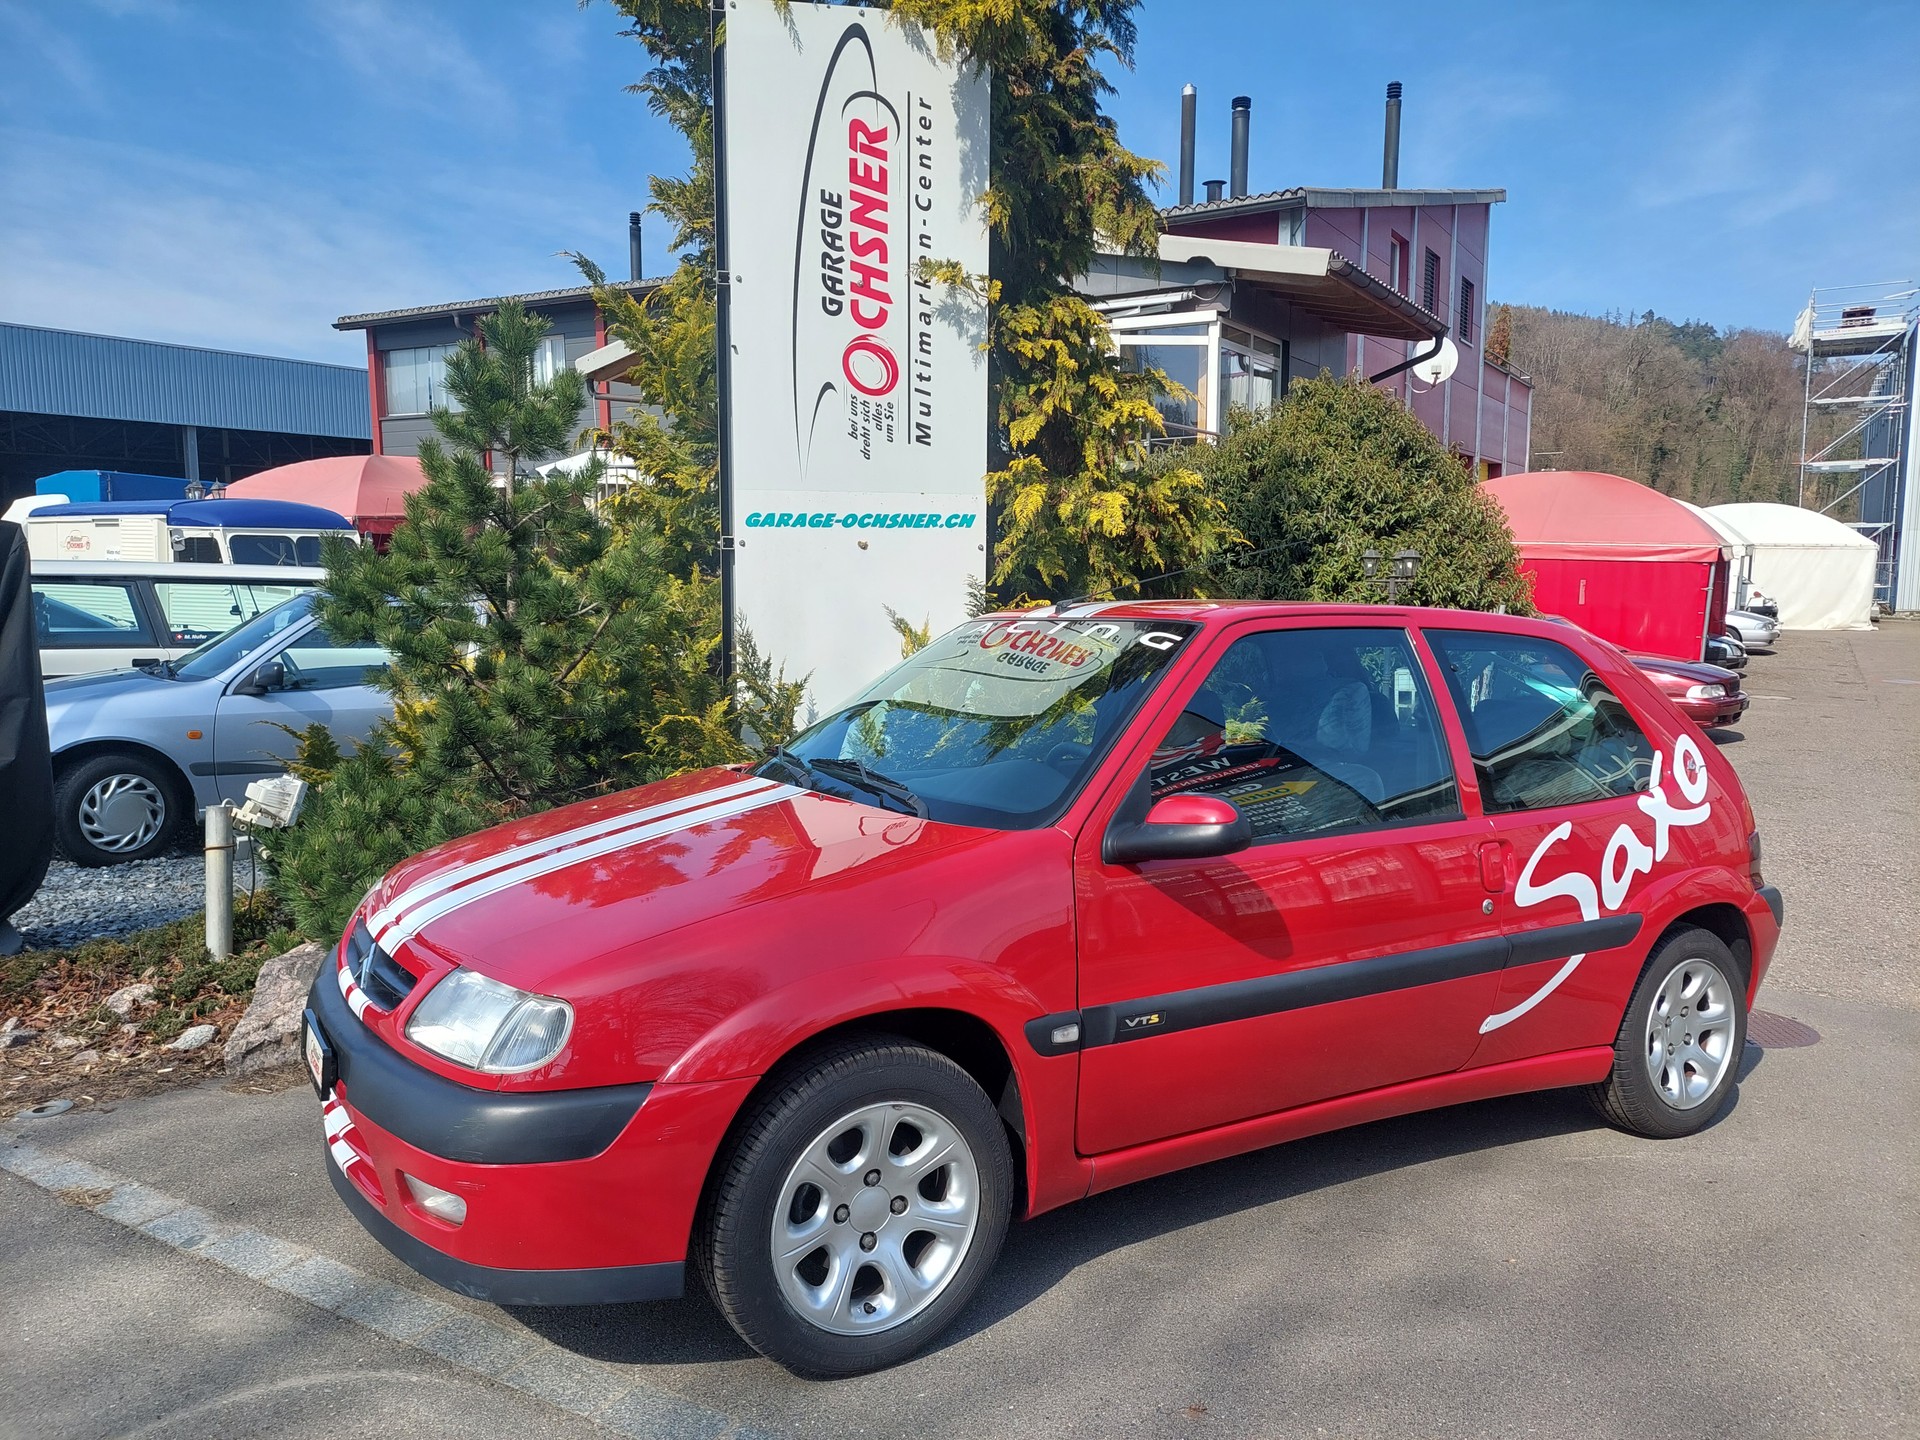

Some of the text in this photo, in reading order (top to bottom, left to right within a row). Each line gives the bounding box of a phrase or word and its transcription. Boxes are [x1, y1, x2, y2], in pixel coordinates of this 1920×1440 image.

[820, 188, 846, 317] GARAGE
[842, 118, 899, 396] OCHSNER
[847, 393, 859, 440] bei uns
[858, 399, 872, 461] dreht sich
[871, 401, 884, 432] alles
[883, 401, 895, 443] um Sie
[745, 512, 977, 529] GARAGE-OCHSNER.CH
[1479, 733, 1712, 1035] Saxo
[1125, 1013, 1160, 1028] VTS
